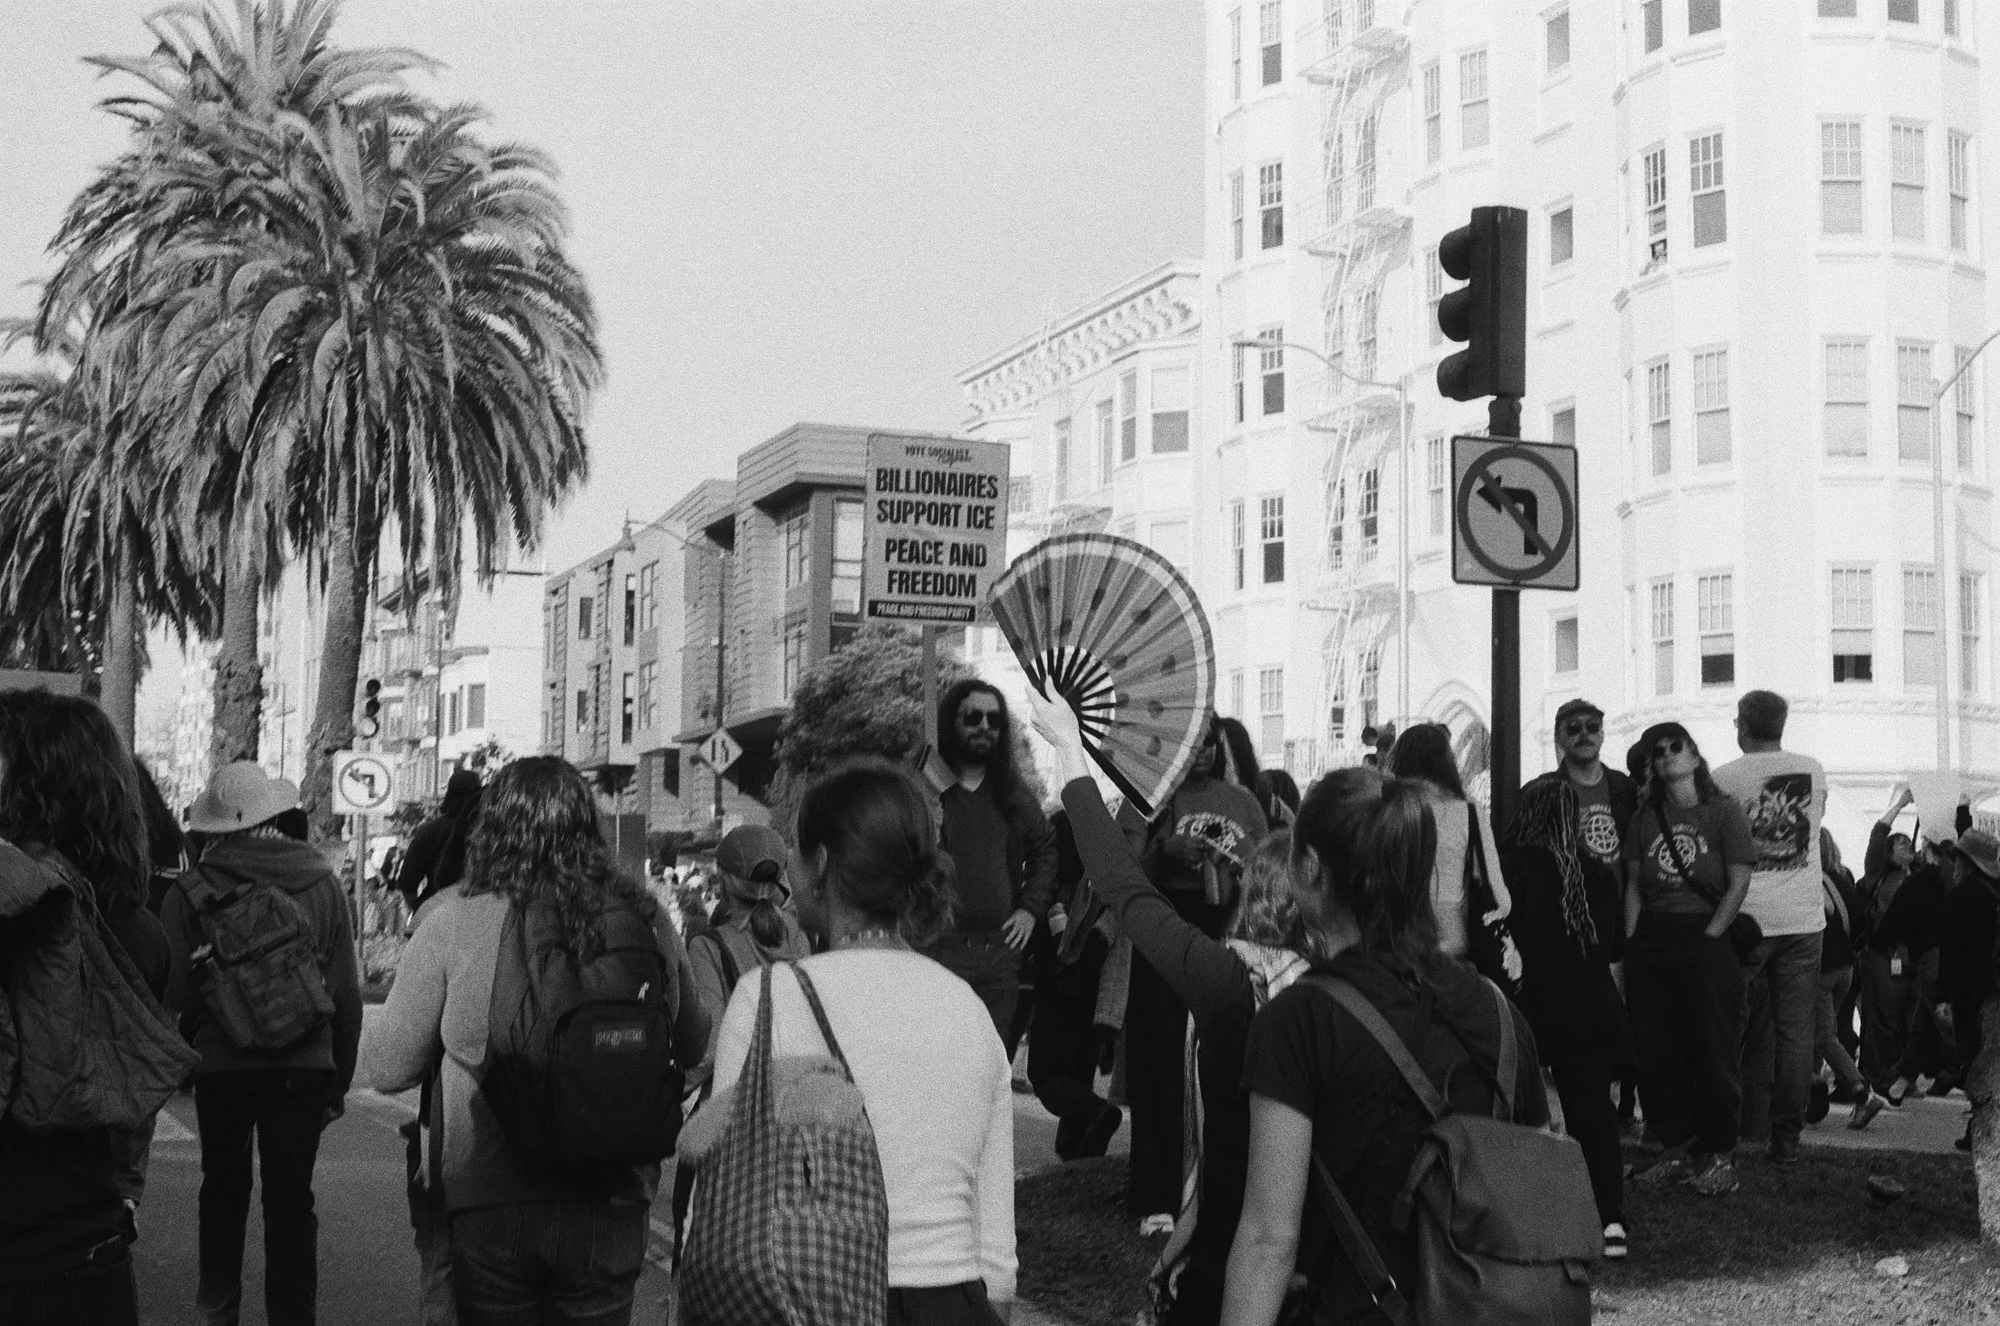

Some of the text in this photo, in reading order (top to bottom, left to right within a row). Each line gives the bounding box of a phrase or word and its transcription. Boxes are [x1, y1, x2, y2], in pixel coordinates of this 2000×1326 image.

[905, 446, 926, 457] VOTE
[876, 467, 999, 499] BILLIONAIRES
[876, 499, 995, 530] SUPPORT ICE
[885, 537, 987, 568] PEACE AND
[887, 569, 977, 598] FREEDOM
[877, 602, 971, 621] PEACE AND FREEDOM PARTY
